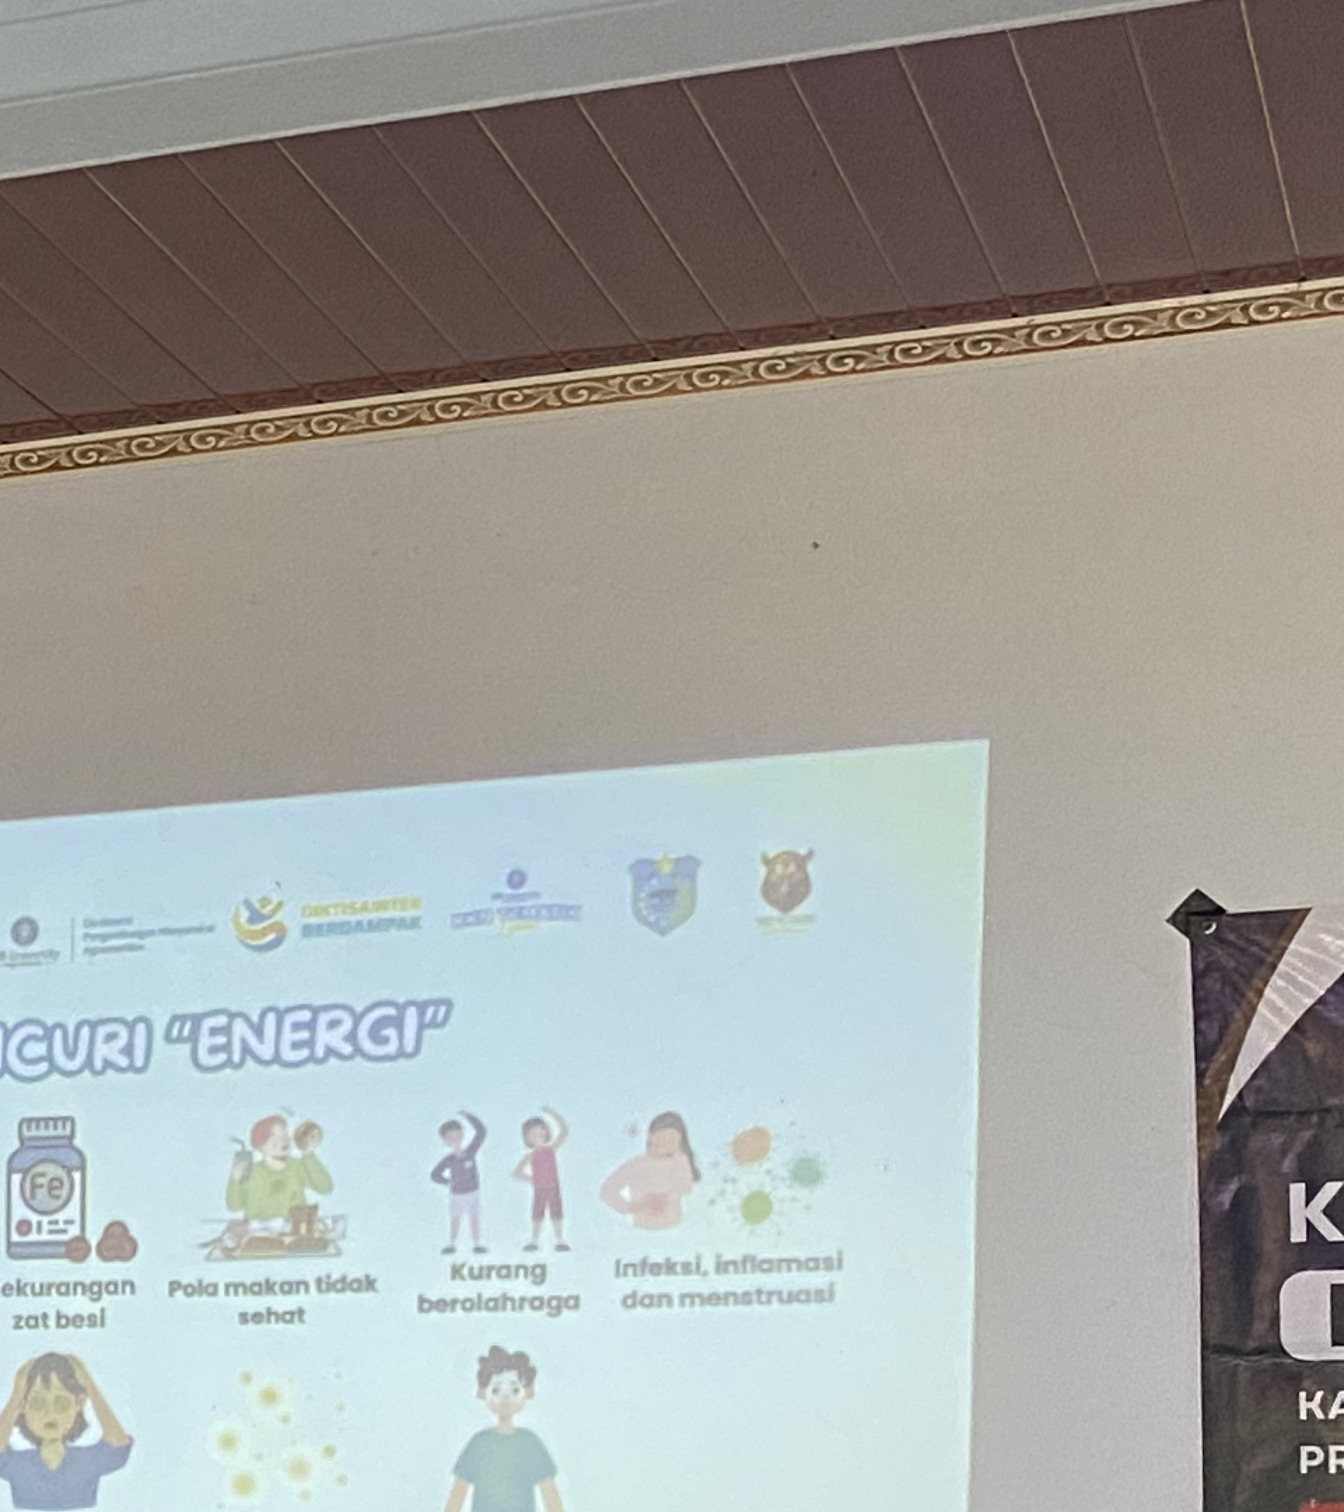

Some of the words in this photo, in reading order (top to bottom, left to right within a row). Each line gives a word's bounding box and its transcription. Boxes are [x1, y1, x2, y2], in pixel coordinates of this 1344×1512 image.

[28, 1172, 65, 1201] Fe
[450, 1261, 548, 1285] Kurang
[615, 1254, 709, 1278] Infeksi,
[714, 1250, 844, 1275] inflamasi
[168, 1278, 219, 1299] Pola
[224, 1277, 311, 1297] makan
[315, 1273, 379, 1295] tidak
[621, 1289, 674, 1310] dan
[678, 1282, 837, 1309] menstruasi
[238, 1306, 306, 1326] sehat
[417, 1291, 580, 1318] berolahraga
[12, 1310, 50, 1330] zat
[55, 1307, 106, 1330] besi
